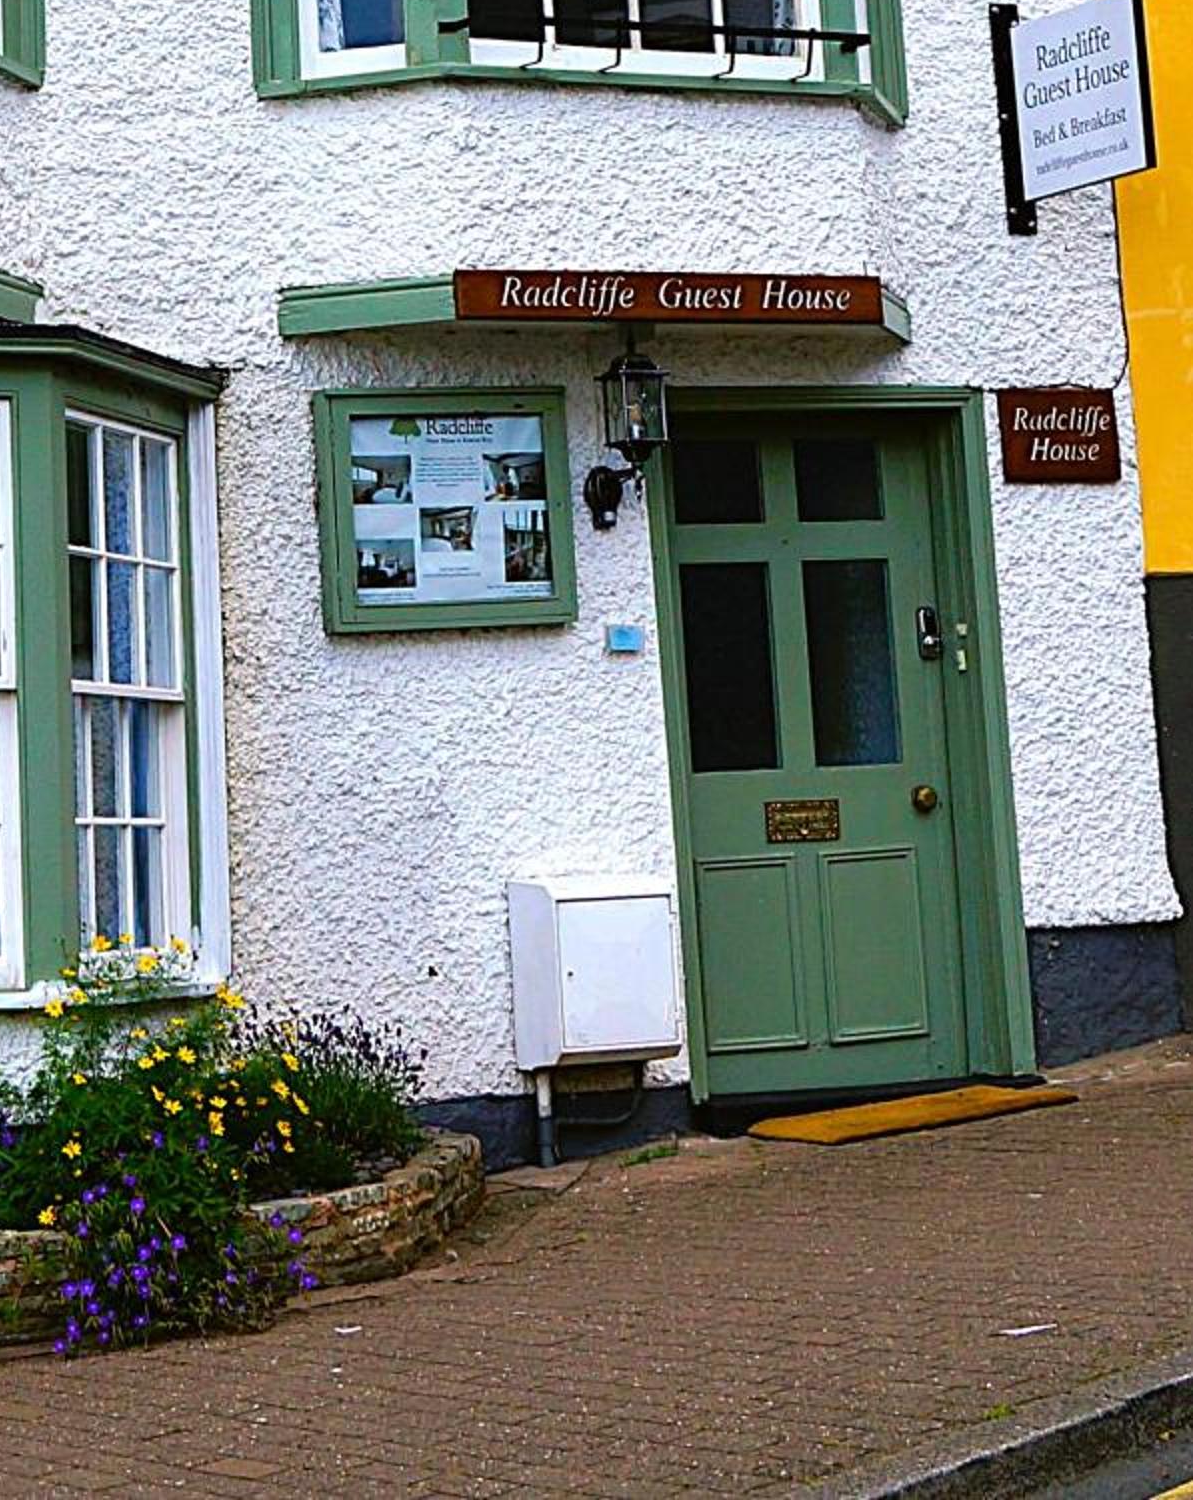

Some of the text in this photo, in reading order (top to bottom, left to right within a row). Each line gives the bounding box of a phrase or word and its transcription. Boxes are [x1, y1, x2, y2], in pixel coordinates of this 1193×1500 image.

[1036, 26, 1111, 71] Radcliffe
[1023, 60, 1129, 109] Guest House
[1033, 108, 1127, 148] Bed & Breakfast
[501, 275, 851, 316] Radcliffe Guest House
[1013, 406, 1110, 437] Radcliffe
[1030, 437, 1099, 461] House
